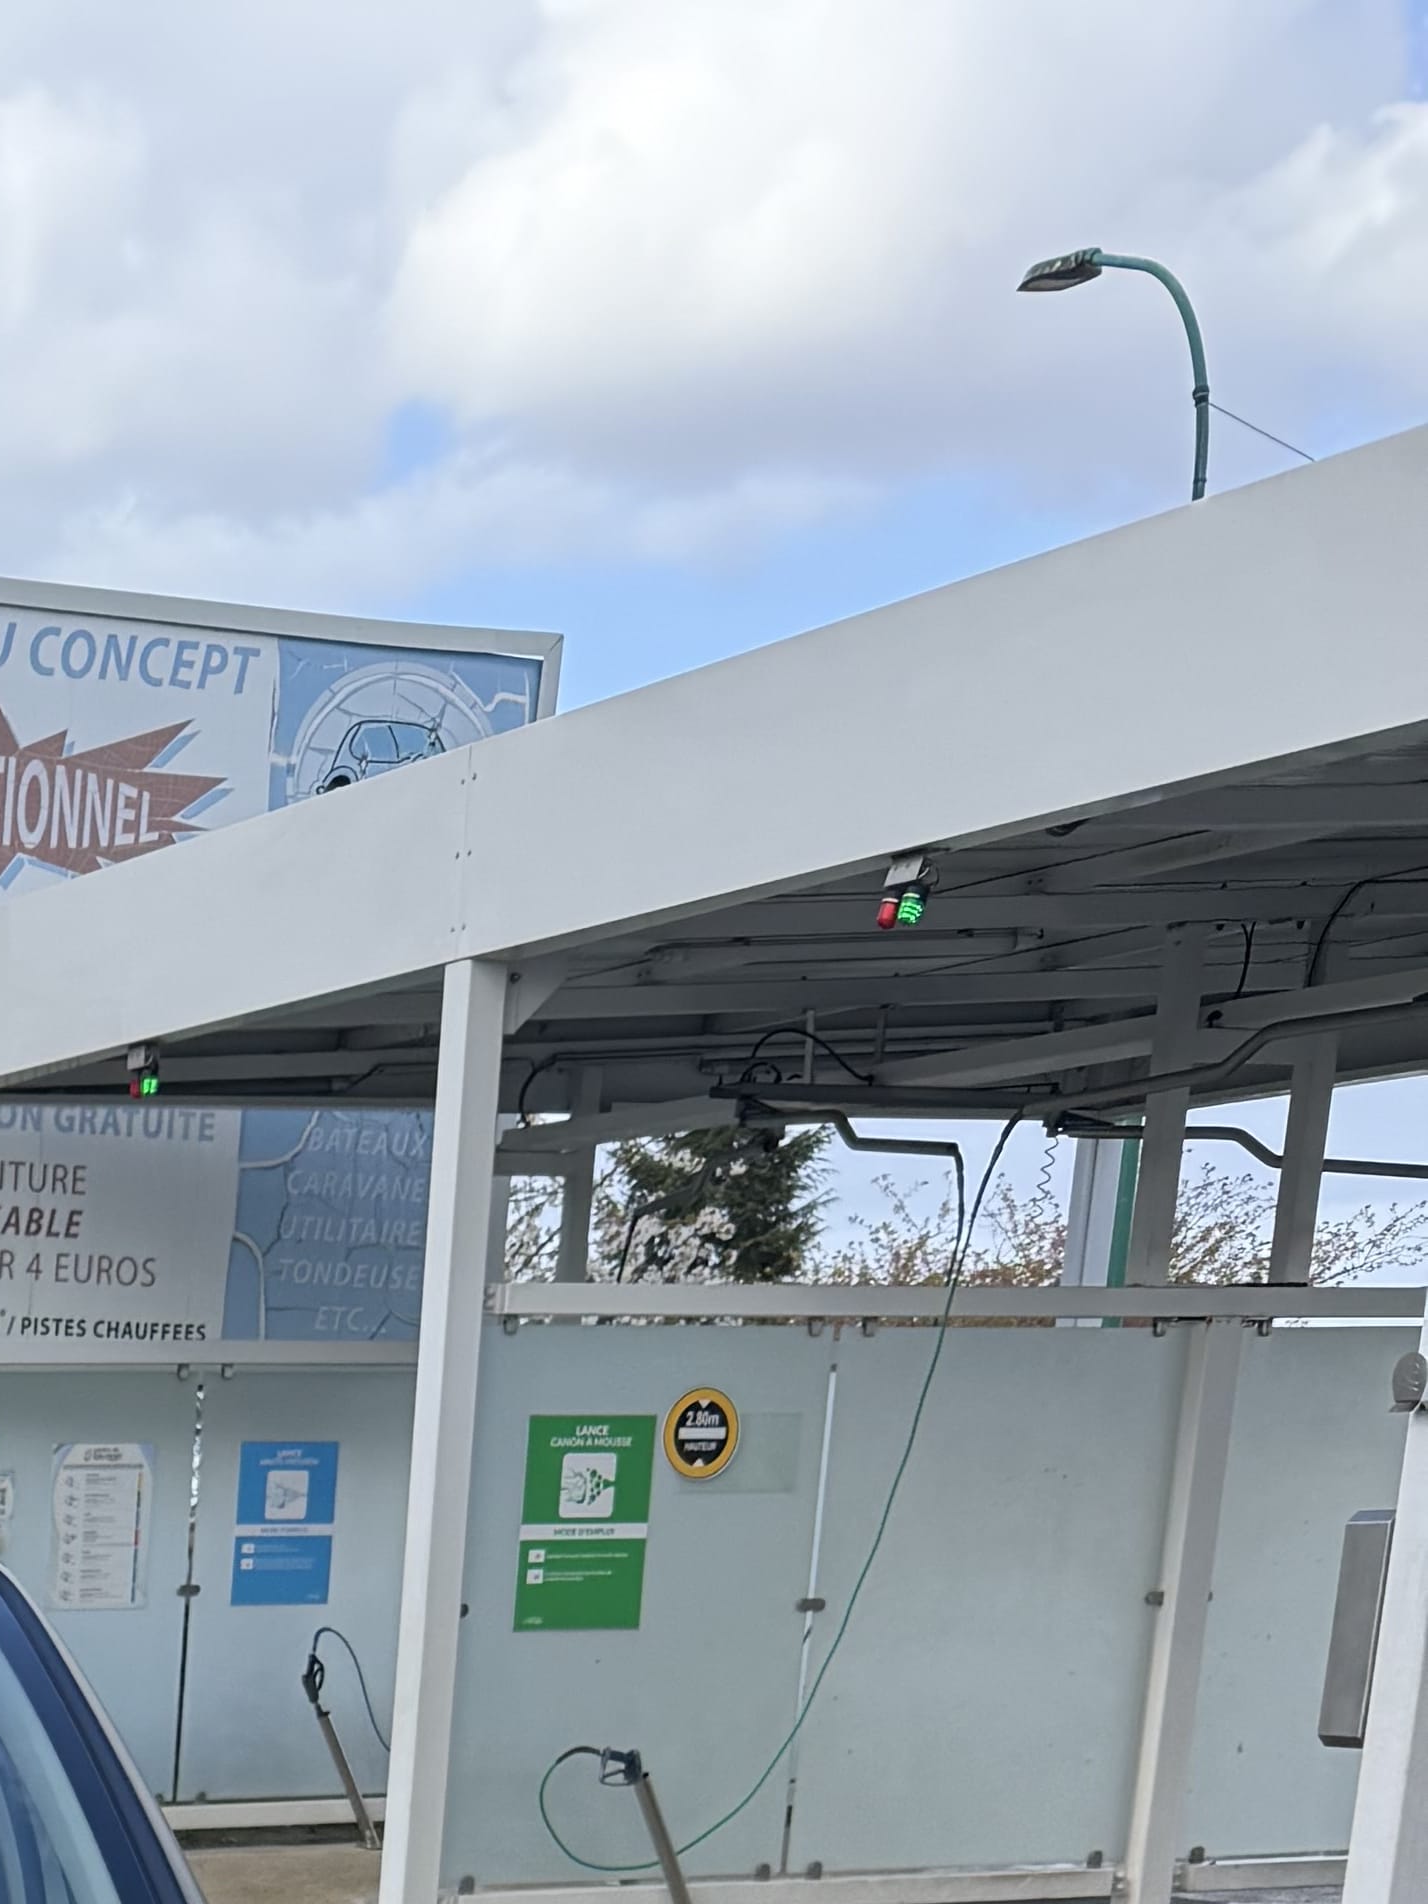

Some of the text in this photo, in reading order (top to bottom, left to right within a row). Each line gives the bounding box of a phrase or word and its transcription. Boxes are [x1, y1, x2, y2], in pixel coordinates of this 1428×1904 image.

[29, 627, 261, 695] CONCEPT
[309, 1126, 428, 1158] BATEAUX
[25, 1253, 43, 1281] 4
[55, 1252, 157, 1288] EUROS
[20, 1317, 86, 1338] PISTES
[93, 1319, 207, 1342] CHAUFFEES
[576, 1425, 609, 1436] LANCE
[686, 1411, 720, 1426] 2.80m
